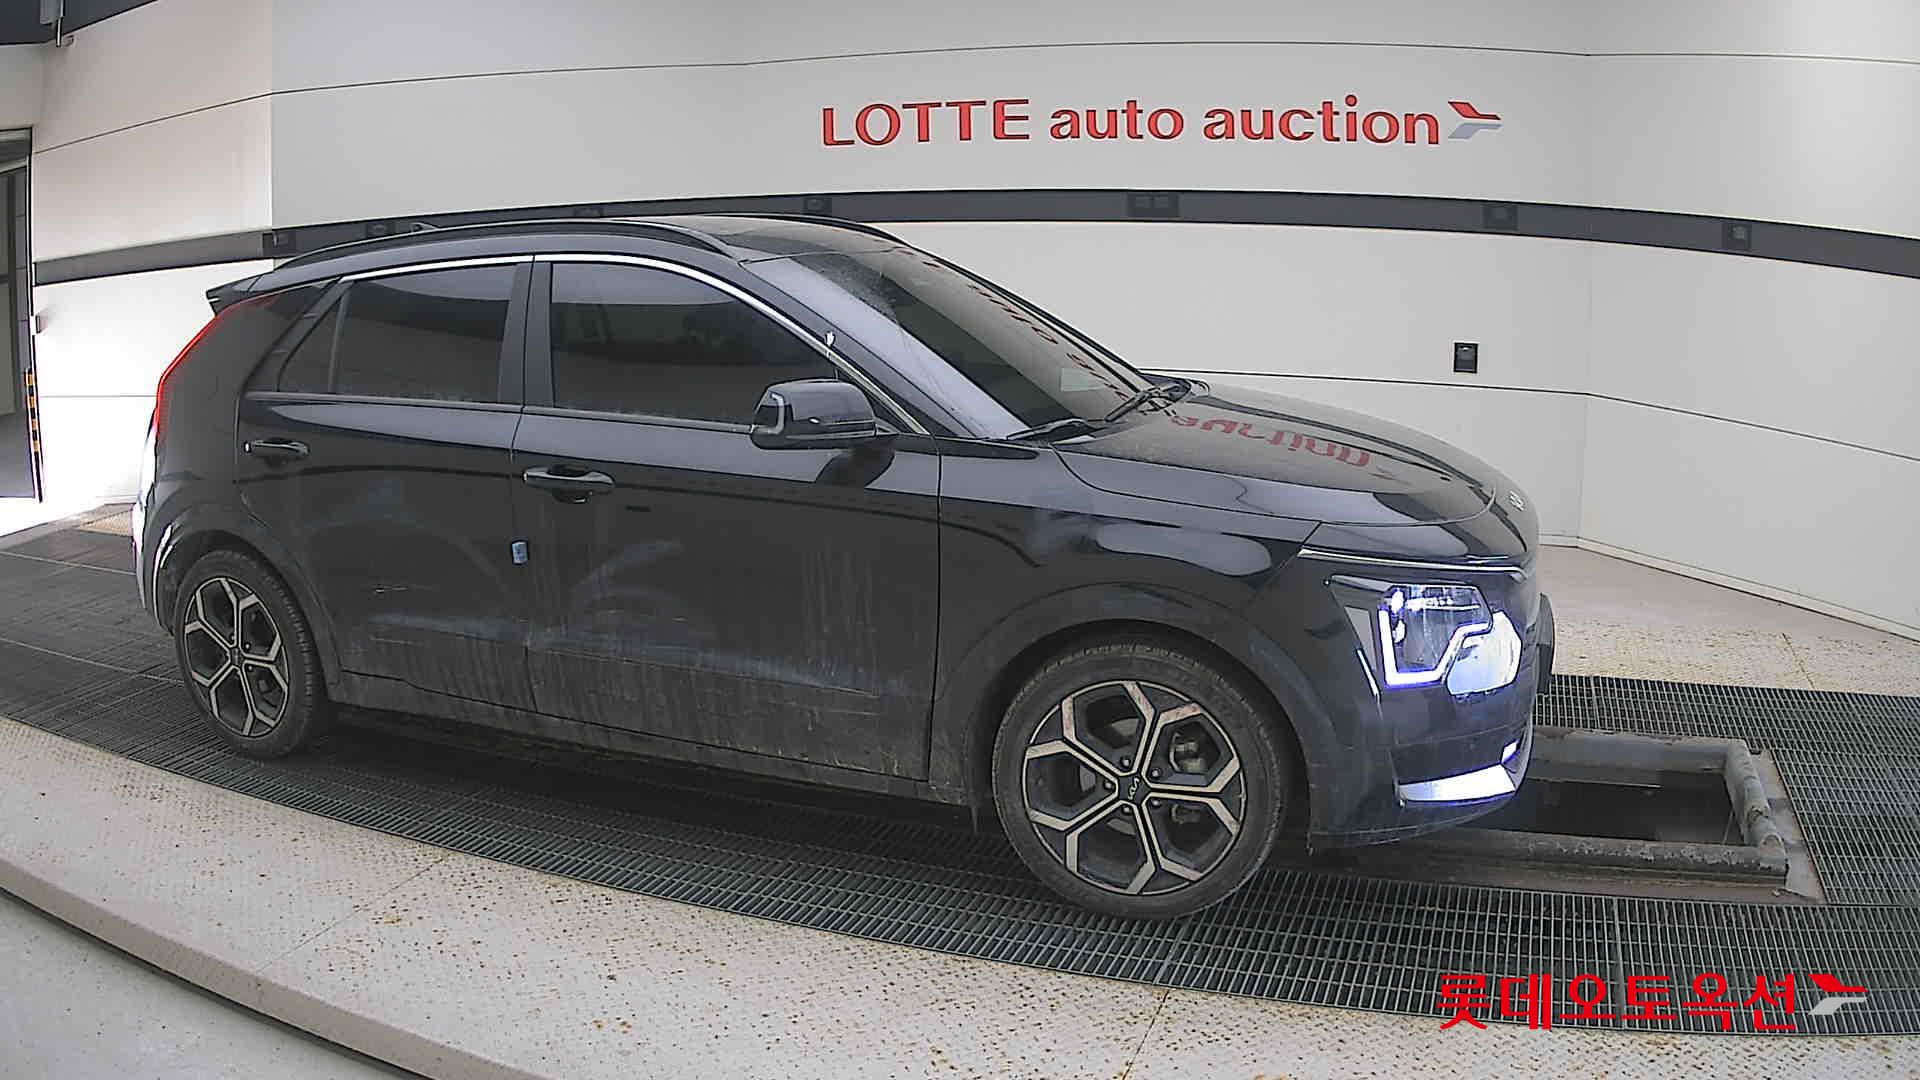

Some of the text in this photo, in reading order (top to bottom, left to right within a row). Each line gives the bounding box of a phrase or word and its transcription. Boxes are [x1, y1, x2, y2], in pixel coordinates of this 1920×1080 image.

[821, 94, 1441, 146] LOTTE auto auction
